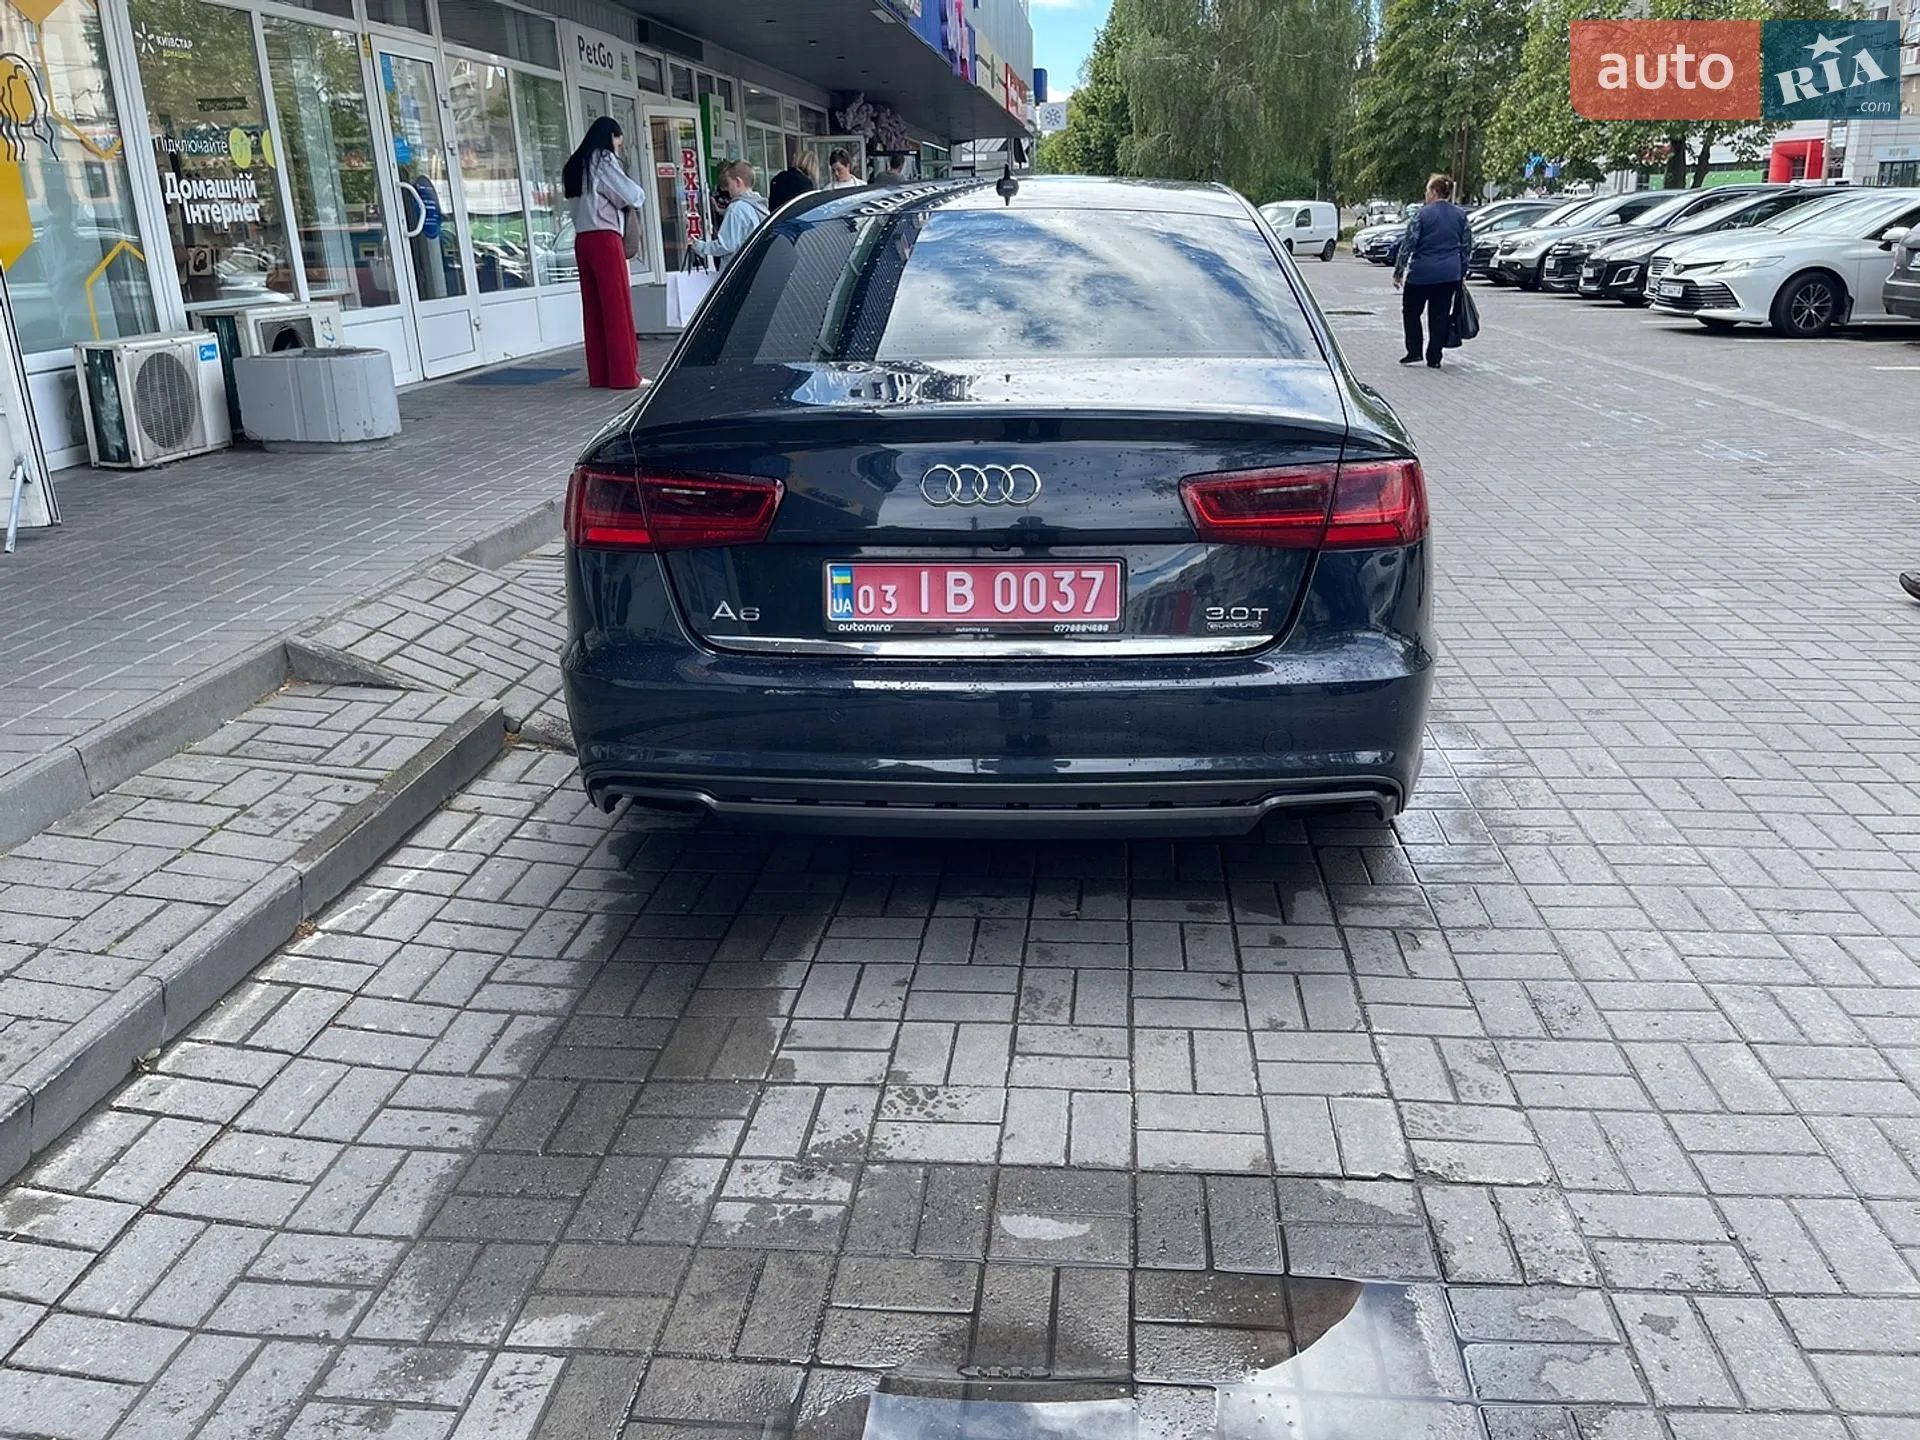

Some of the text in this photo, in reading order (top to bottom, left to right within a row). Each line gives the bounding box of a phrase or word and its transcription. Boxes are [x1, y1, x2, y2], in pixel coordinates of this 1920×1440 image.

[577, 35, 614, 70] PetGo
[154, 134, 228, 154] Підключайте
[165, 172, 258, 204] Домашній
[681, 148, 703, 245] ВХІД
[183, 199, 260, 229] Інтернет
[833, 598, 853, 613] UA
[858, 585, 897, 614] 03
[994, 571, 1105, 613] 0037
[711, 600, 760, 621] A6
[1206, 607, 1269, 620] 3.0T
